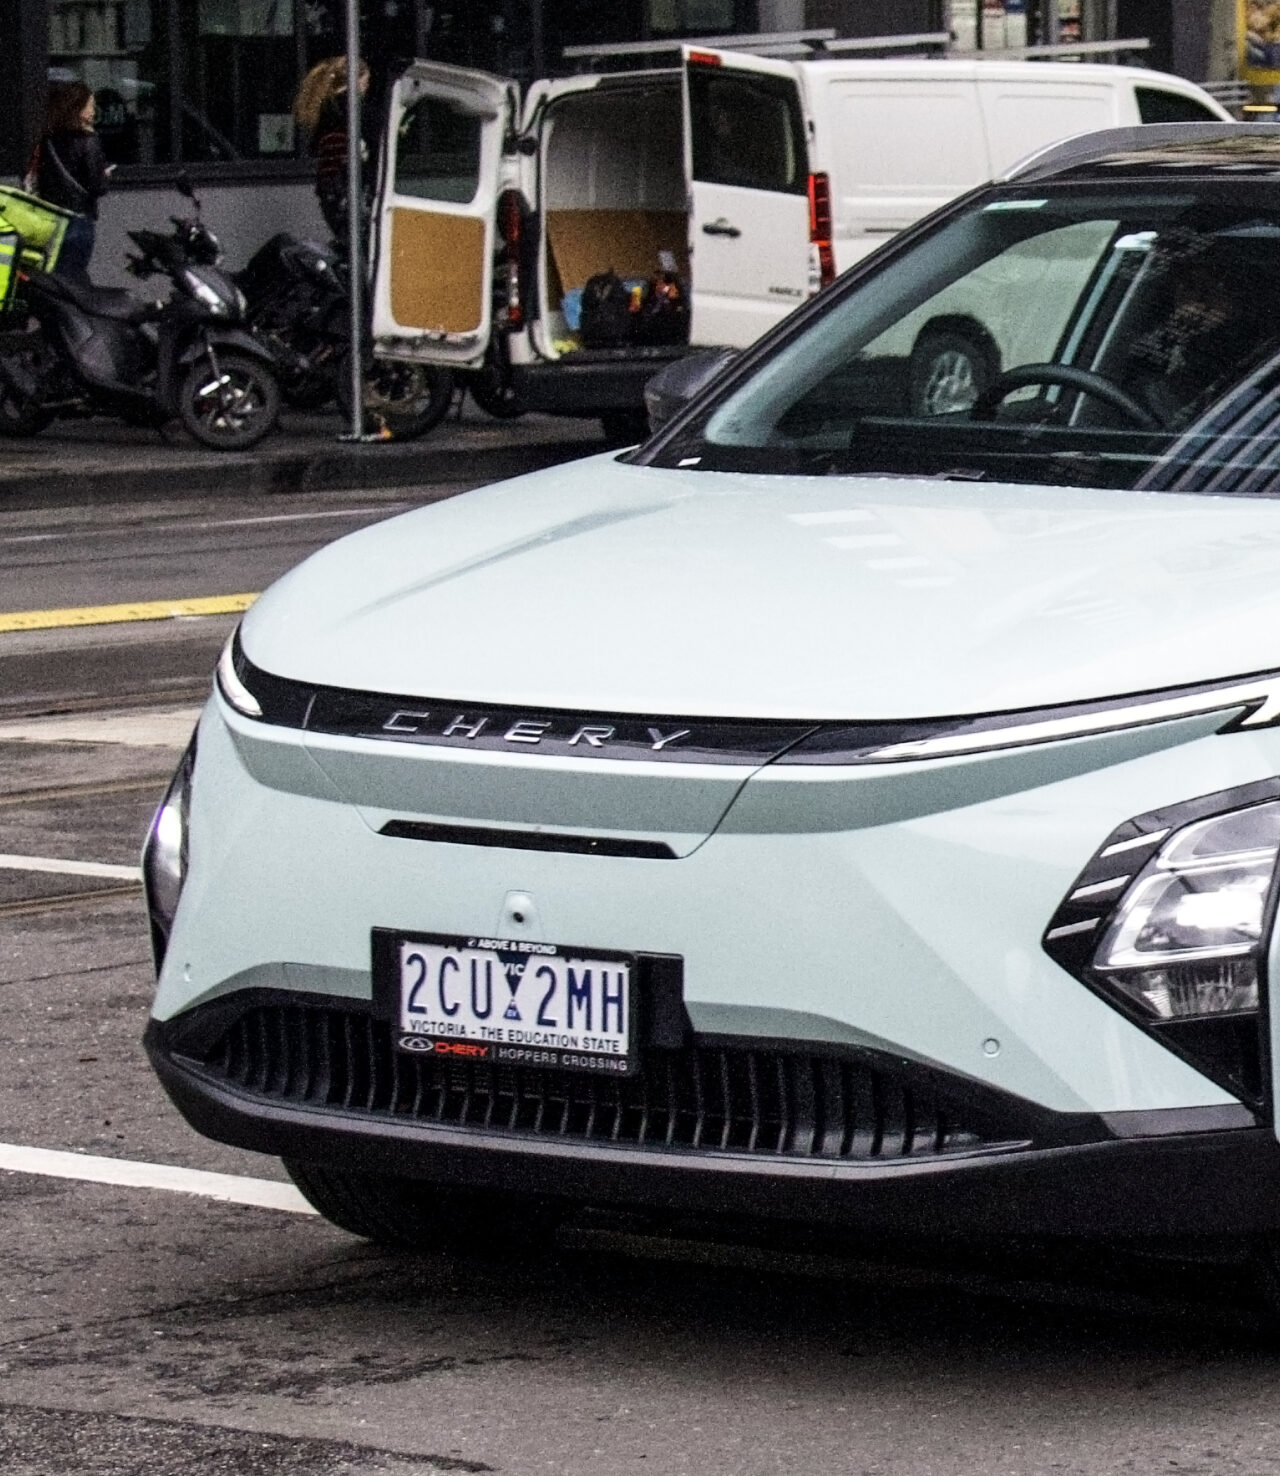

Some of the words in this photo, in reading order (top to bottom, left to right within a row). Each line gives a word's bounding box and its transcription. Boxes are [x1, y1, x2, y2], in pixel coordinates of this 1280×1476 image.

[382, 710, 690, 750] CHERY
[477, 938, 509, 951] ABOVE
[510, 941, 518, 952] &
[519, 942, 557, 955] BEYOND
[406, 952, 493, 1020] 2CU
[535, 964, 625, 1034] 2MH
[409, 1019, 467, 1036] VICTORIA
[481, 1026, 504, 1041] THE
[508, 1029, 578, 1048] EDUCATION
[582, 1037, 620, 1053] STATE
[435, 1041, 489, 1057] CHERY
[498, 1048, 558, 1064] HOPPERS
[561, 1053, 628, 1071] CROSSING
